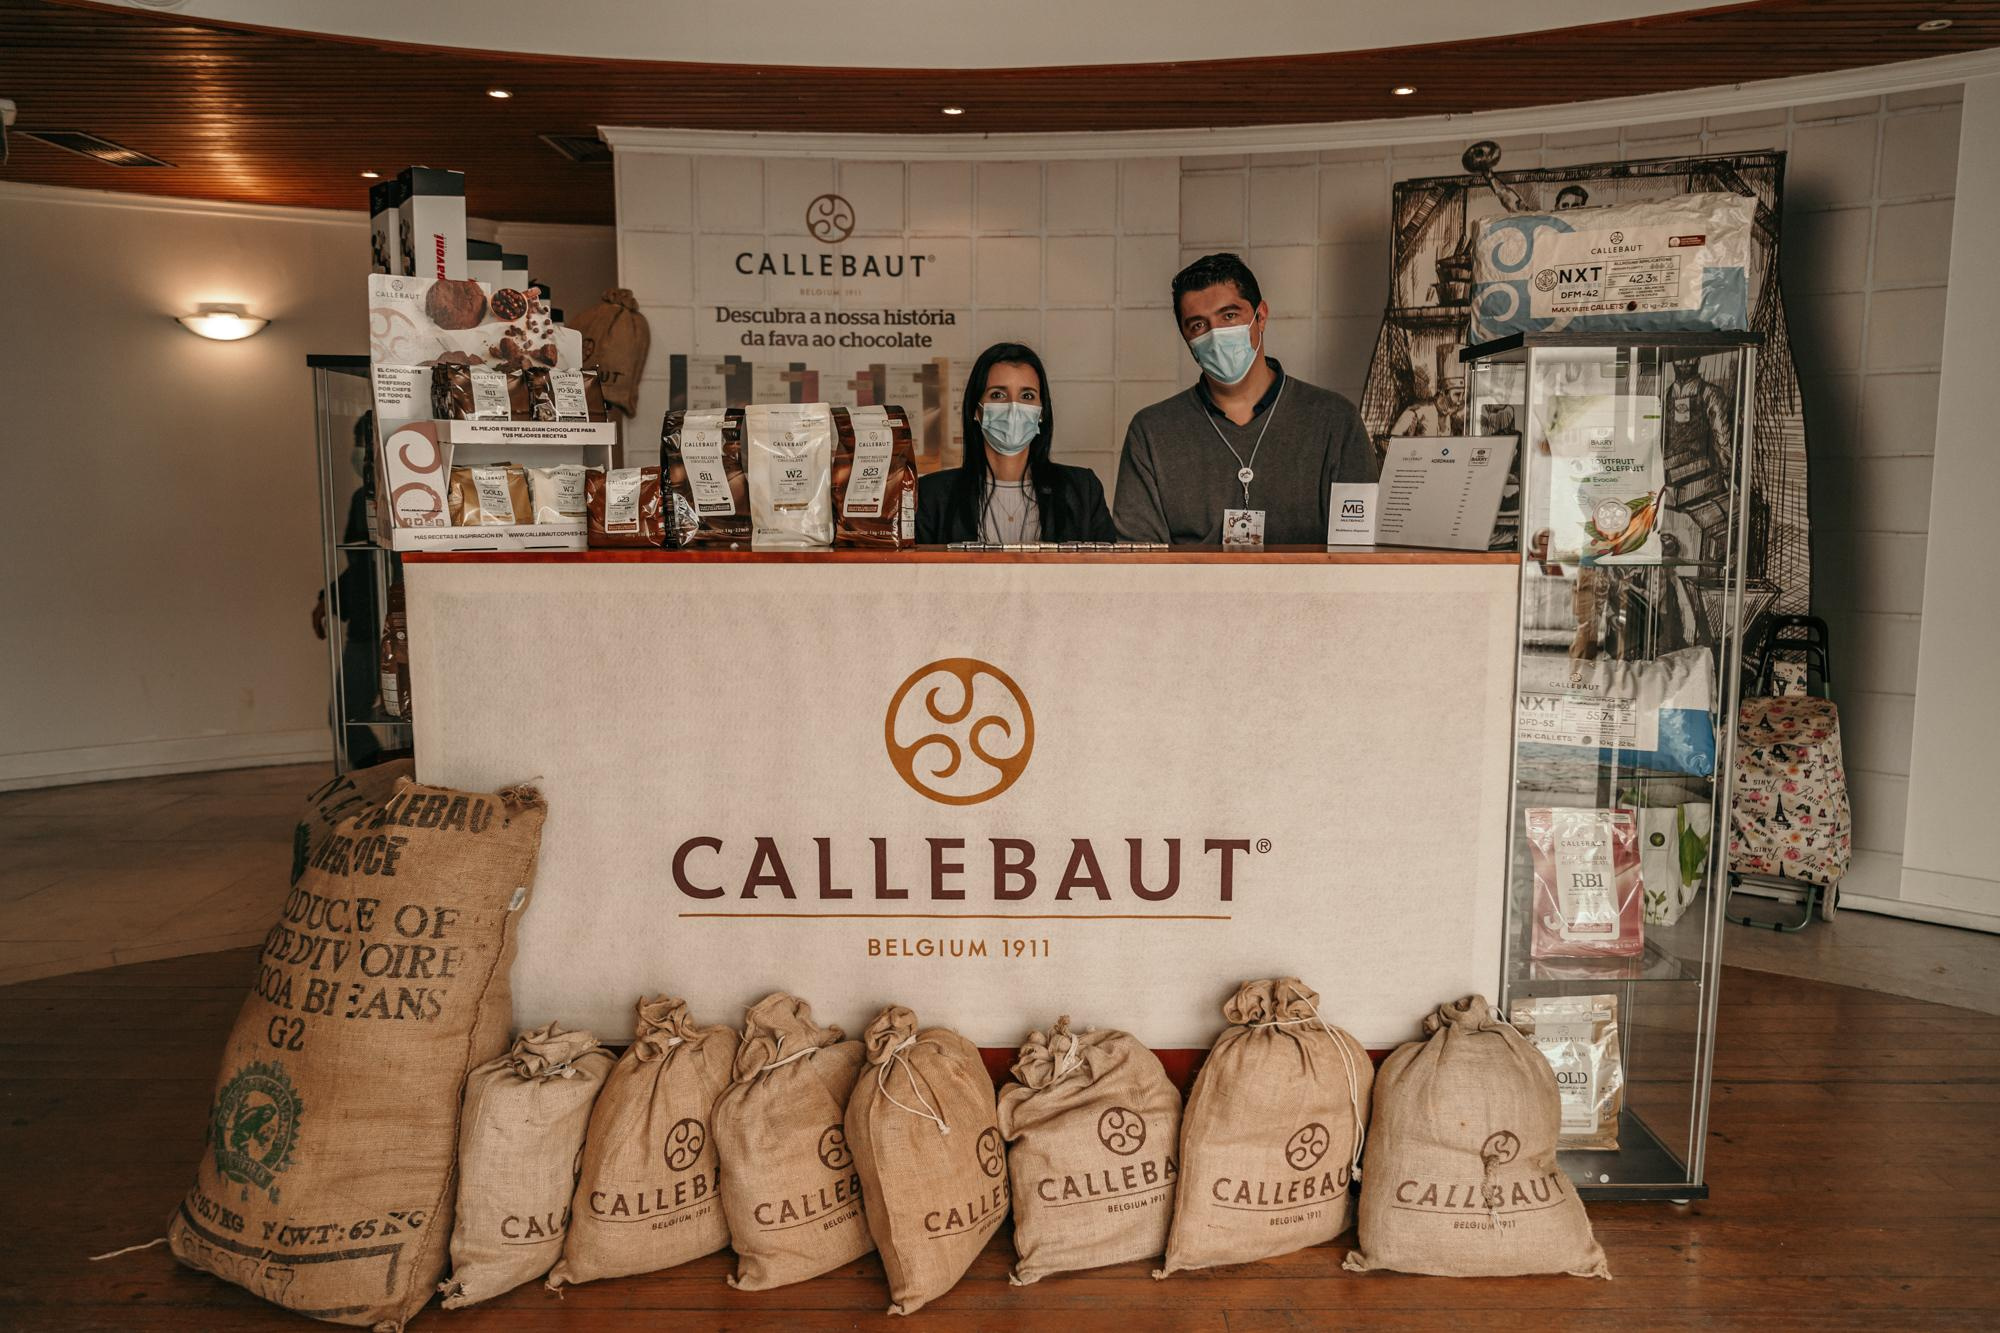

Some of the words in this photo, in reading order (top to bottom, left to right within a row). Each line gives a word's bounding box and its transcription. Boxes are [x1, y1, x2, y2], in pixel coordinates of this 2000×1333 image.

[1591, 245, 1644, 255] CALLEBAUT
[1559, 266, 1602, 284] NXT
[1560, 289, 1599, 299] DFM-42
[715, 307, 805, 325] Descubra
[810, 312, 820, 324] a
[825, 312, 880, 326] nossa
[884, 309, 956, 326] história
[741, 331, 765, 347] da
[769, 331, 808, 347] fava
[813, 335, 835, 348] ao
[839, 331, 932, 348] chocolate
[699, 473, 713, 481] 811
[785, 470, 803, 479] W2
[862, 468, 879, 477] 823
[1342, 504, 1364, 514] MB
[1549, 682, 1599, 690] CALLEBAUT
[1572, 873, 1604, 887] RB1
[394, 904, 460, 939] OF
[868, 938, 988, 958] BELGIUM
[1001, 938, 1050, 958] 1911
[268, 1015, 306, 1051] G2
[1556, 1071, 1588, 1084] OLD
[1107, 1199, 1148, 1213] BELGIUM
[1151, 1194, 1166, 1204] 1911
[651, 1213, 692, 1231] BELGIUM
[1269, 1212, 1305, 1226] BELGIUM
[1306, 1209, 1322, 1220] 1911
[350, 1219, 378, 1241] 65
[1453, 1221, 1495, 1231] BELGIUM
